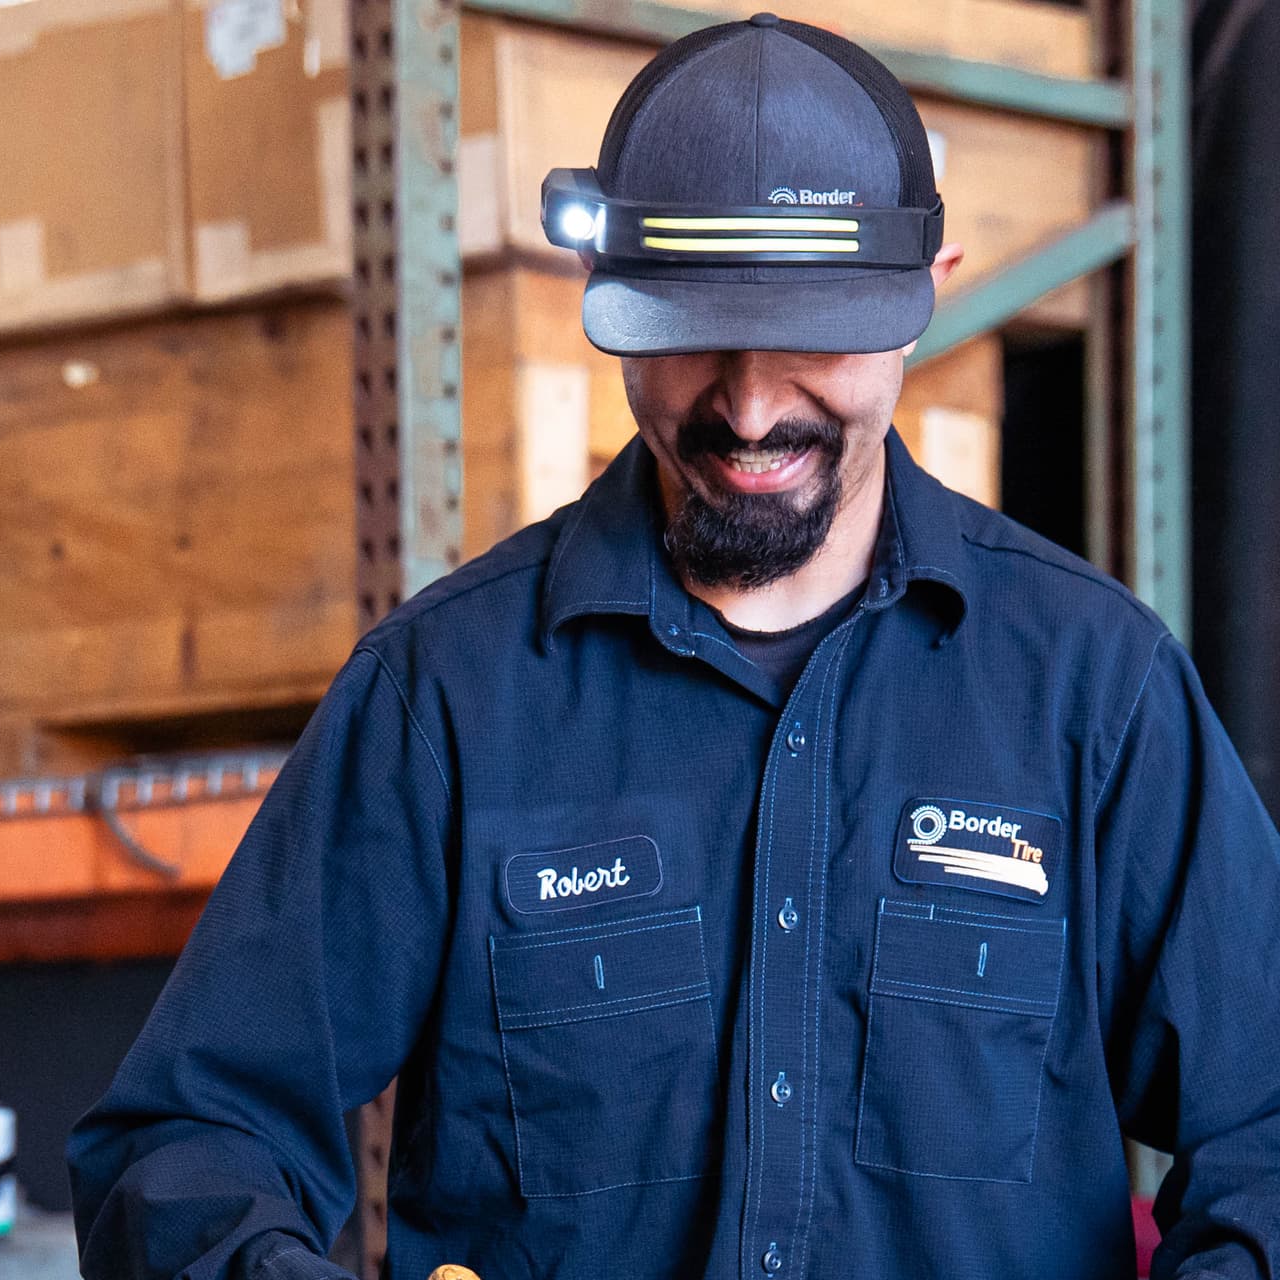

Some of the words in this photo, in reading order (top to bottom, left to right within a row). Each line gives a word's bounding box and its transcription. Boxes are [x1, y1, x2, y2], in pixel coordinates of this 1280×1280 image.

[799, 189, 856, 206] Border
[948, 809, 1022, 841] Border
[1011, 838, 1044, 864] Tire
[536, 857, 631, 901] Robert
